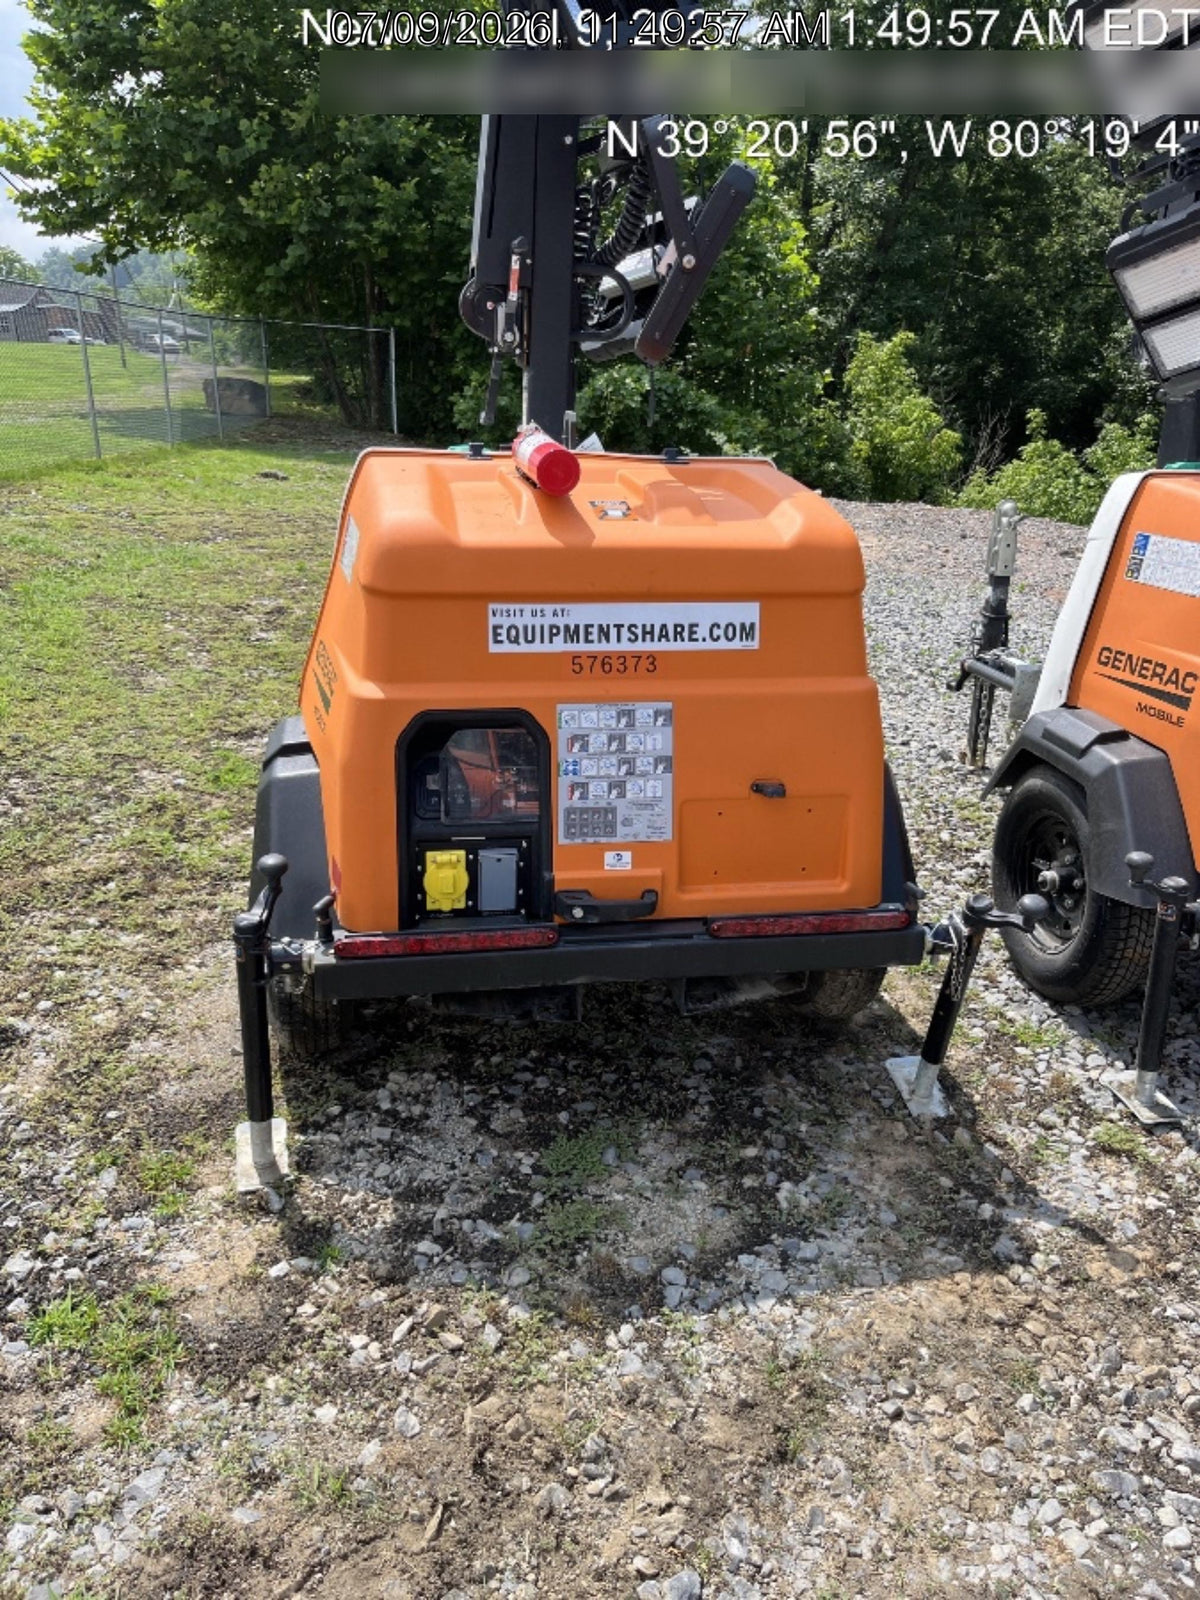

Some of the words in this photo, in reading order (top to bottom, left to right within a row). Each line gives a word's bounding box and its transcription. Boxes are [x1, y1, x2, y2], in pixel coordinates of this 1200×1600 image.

[491, 607, 525, 618] VISIT
[530, 607, 546, 618] US
[552, 607, 571, 618] AT:
[491, 622, 757, 646] EQUIPMENTSHARE.COM
[571, 654, 658, 675] 576373
[1096, 646, 1199, 694] GENERAC
[1135, 701, 1186, 728] MOBILE
